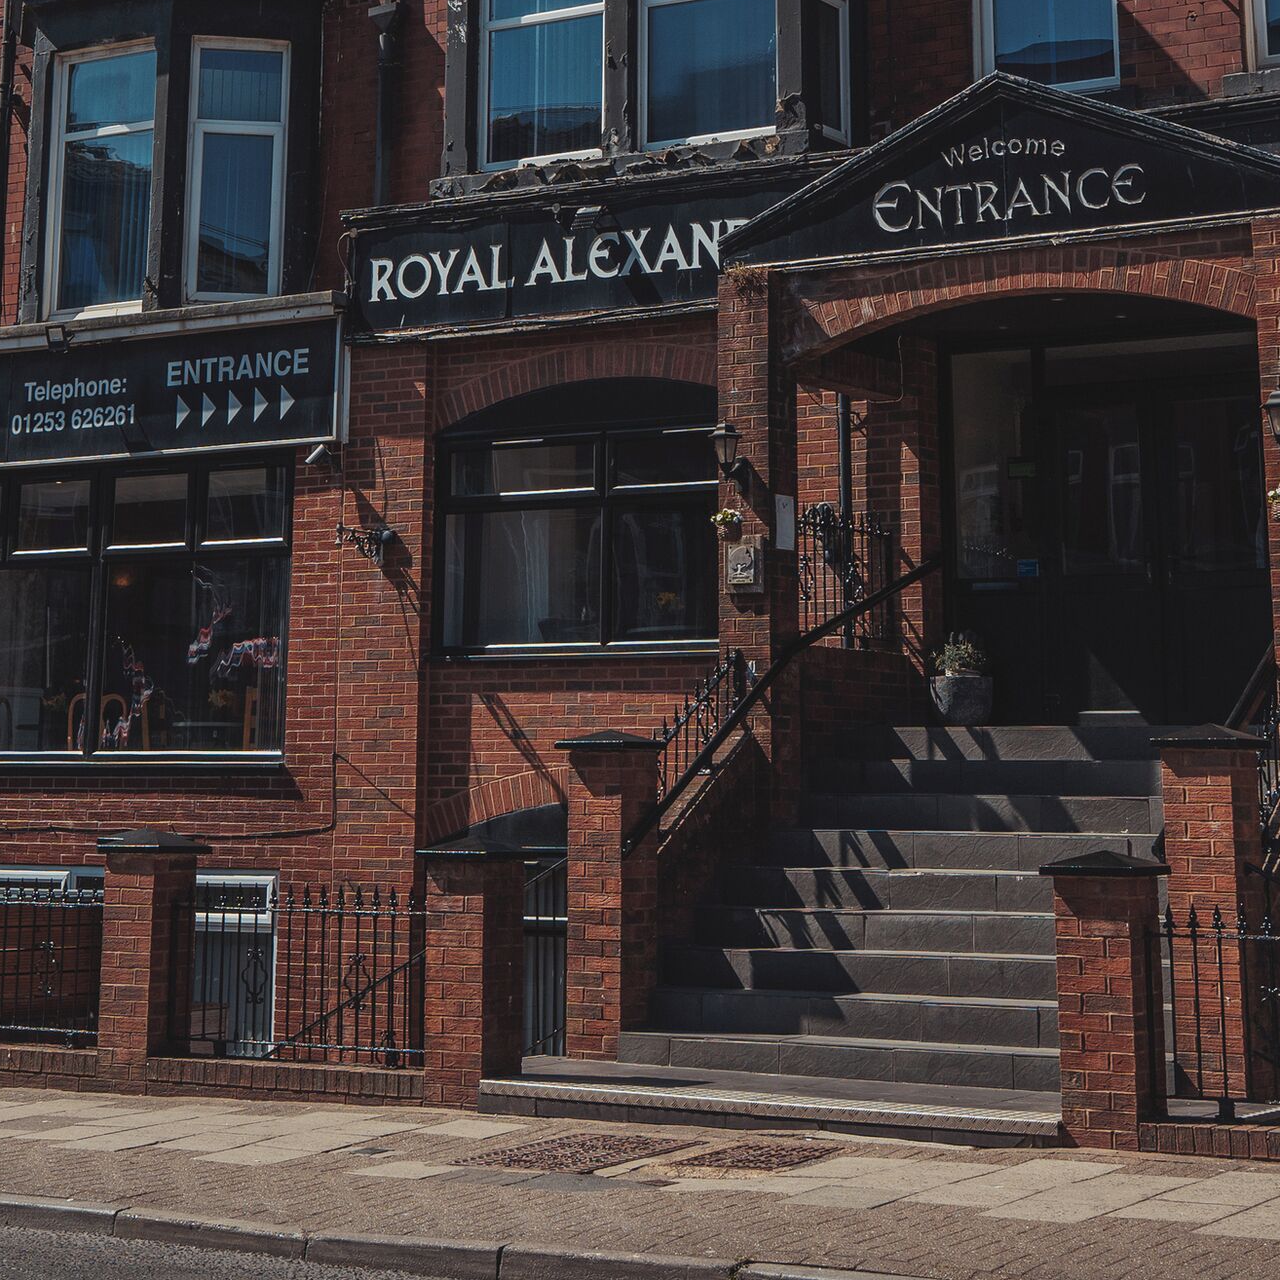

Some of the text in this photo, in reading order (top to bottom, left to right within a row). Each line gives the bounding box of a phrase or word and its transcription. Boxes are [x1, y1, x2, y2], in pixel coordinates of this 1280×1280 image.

[941, 136, 1066, 169] Welcome
[872, 163, 1147, 233] ENTRANCE
[368, 244, 515, 303] ROYAL
[166, 347, 310, 387] ENTRANCE
[24, 376, 128, 404] Telephone:
[11, 403, 137, 436] 01253 626261
